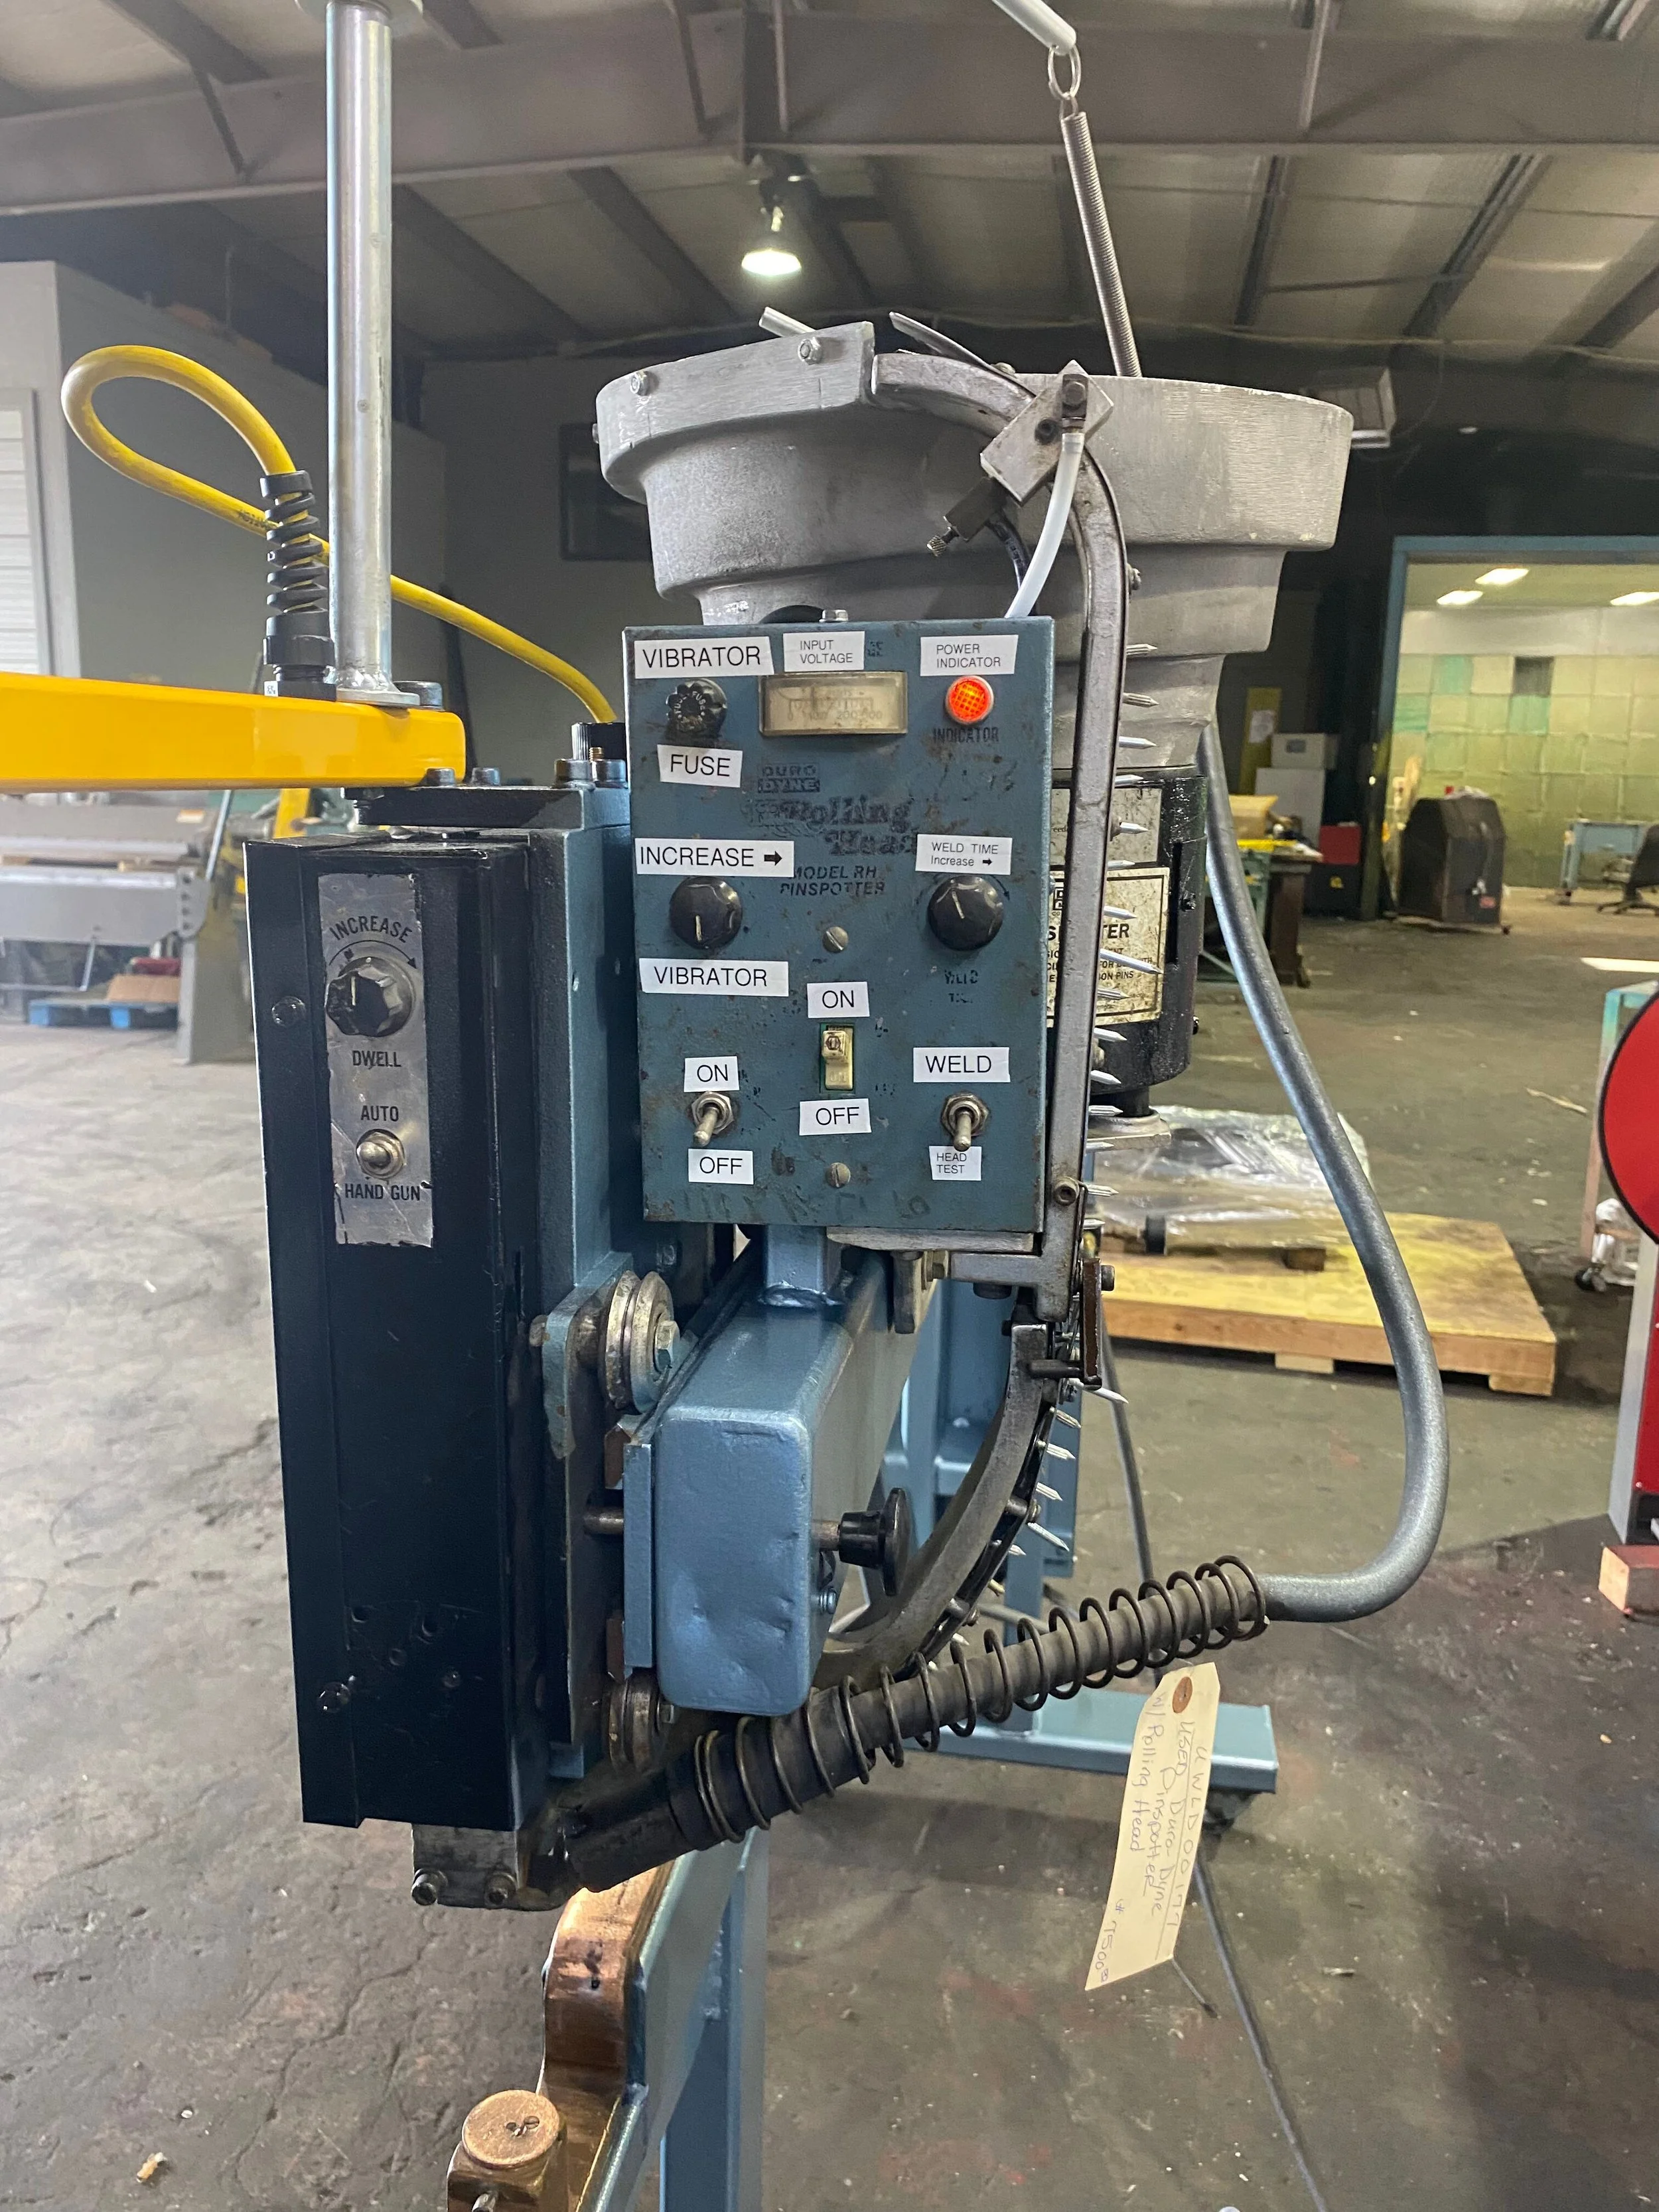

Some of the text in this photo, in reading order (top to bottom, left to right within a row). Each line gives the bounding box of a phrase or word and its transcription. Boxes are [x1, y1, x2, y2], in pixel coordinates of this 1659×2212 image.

[800, 640, 833, 650] INPUT
[936, 644, 980, 654] POWER
[642, 646, 760, 668] VIBRATOR
[800, 653, 853, 664] VOLTAGE
[936, 657, 1001, 668] INDICATOR
[933, 727, 1000, 743] INDICATOR
[670, 754, 731, 777] FUSE
[763, 765, 816, 776] DURO
[762, 778, 817, 792] DYNE
[640, 847, 755, 867] INCREASE
[931, 842, 999, 855] WELD TIME
[931, 855, 974, 867] Increase
[853, 865, 877, 878] RH
[780, 881, 885, 897] PINSPOTTER
[330, 915, 413, 943] INCREASE
[654, 966, 767, 987] VIBRATOR
[1116, 971, 1133, 980] PINS
[822, 990, 855, 1009] ON
[352, 1050, 402, 1069] DWELL
[925, 1056, 992, 1074] WELD
[697, 1065, 728, 1082] ON
[360, 1106, 399, 1122] AUTO
[816, 1107, 860, 1126] OFF
[936, 1152, 967, 1162] HEAD
[699, 1157, 743, 1175] OFF
[938, 1165, 965, 1174] TEST
[344, 1184, 421, 1201] HAND GUN
[1131, 1724, 1165, 1787] Rolling
[1178, 1721, 1194, 1776] USED
[1130, 1799, 1150, 1852] Head
[1152, 1864, 1175, 1917] Dyne
